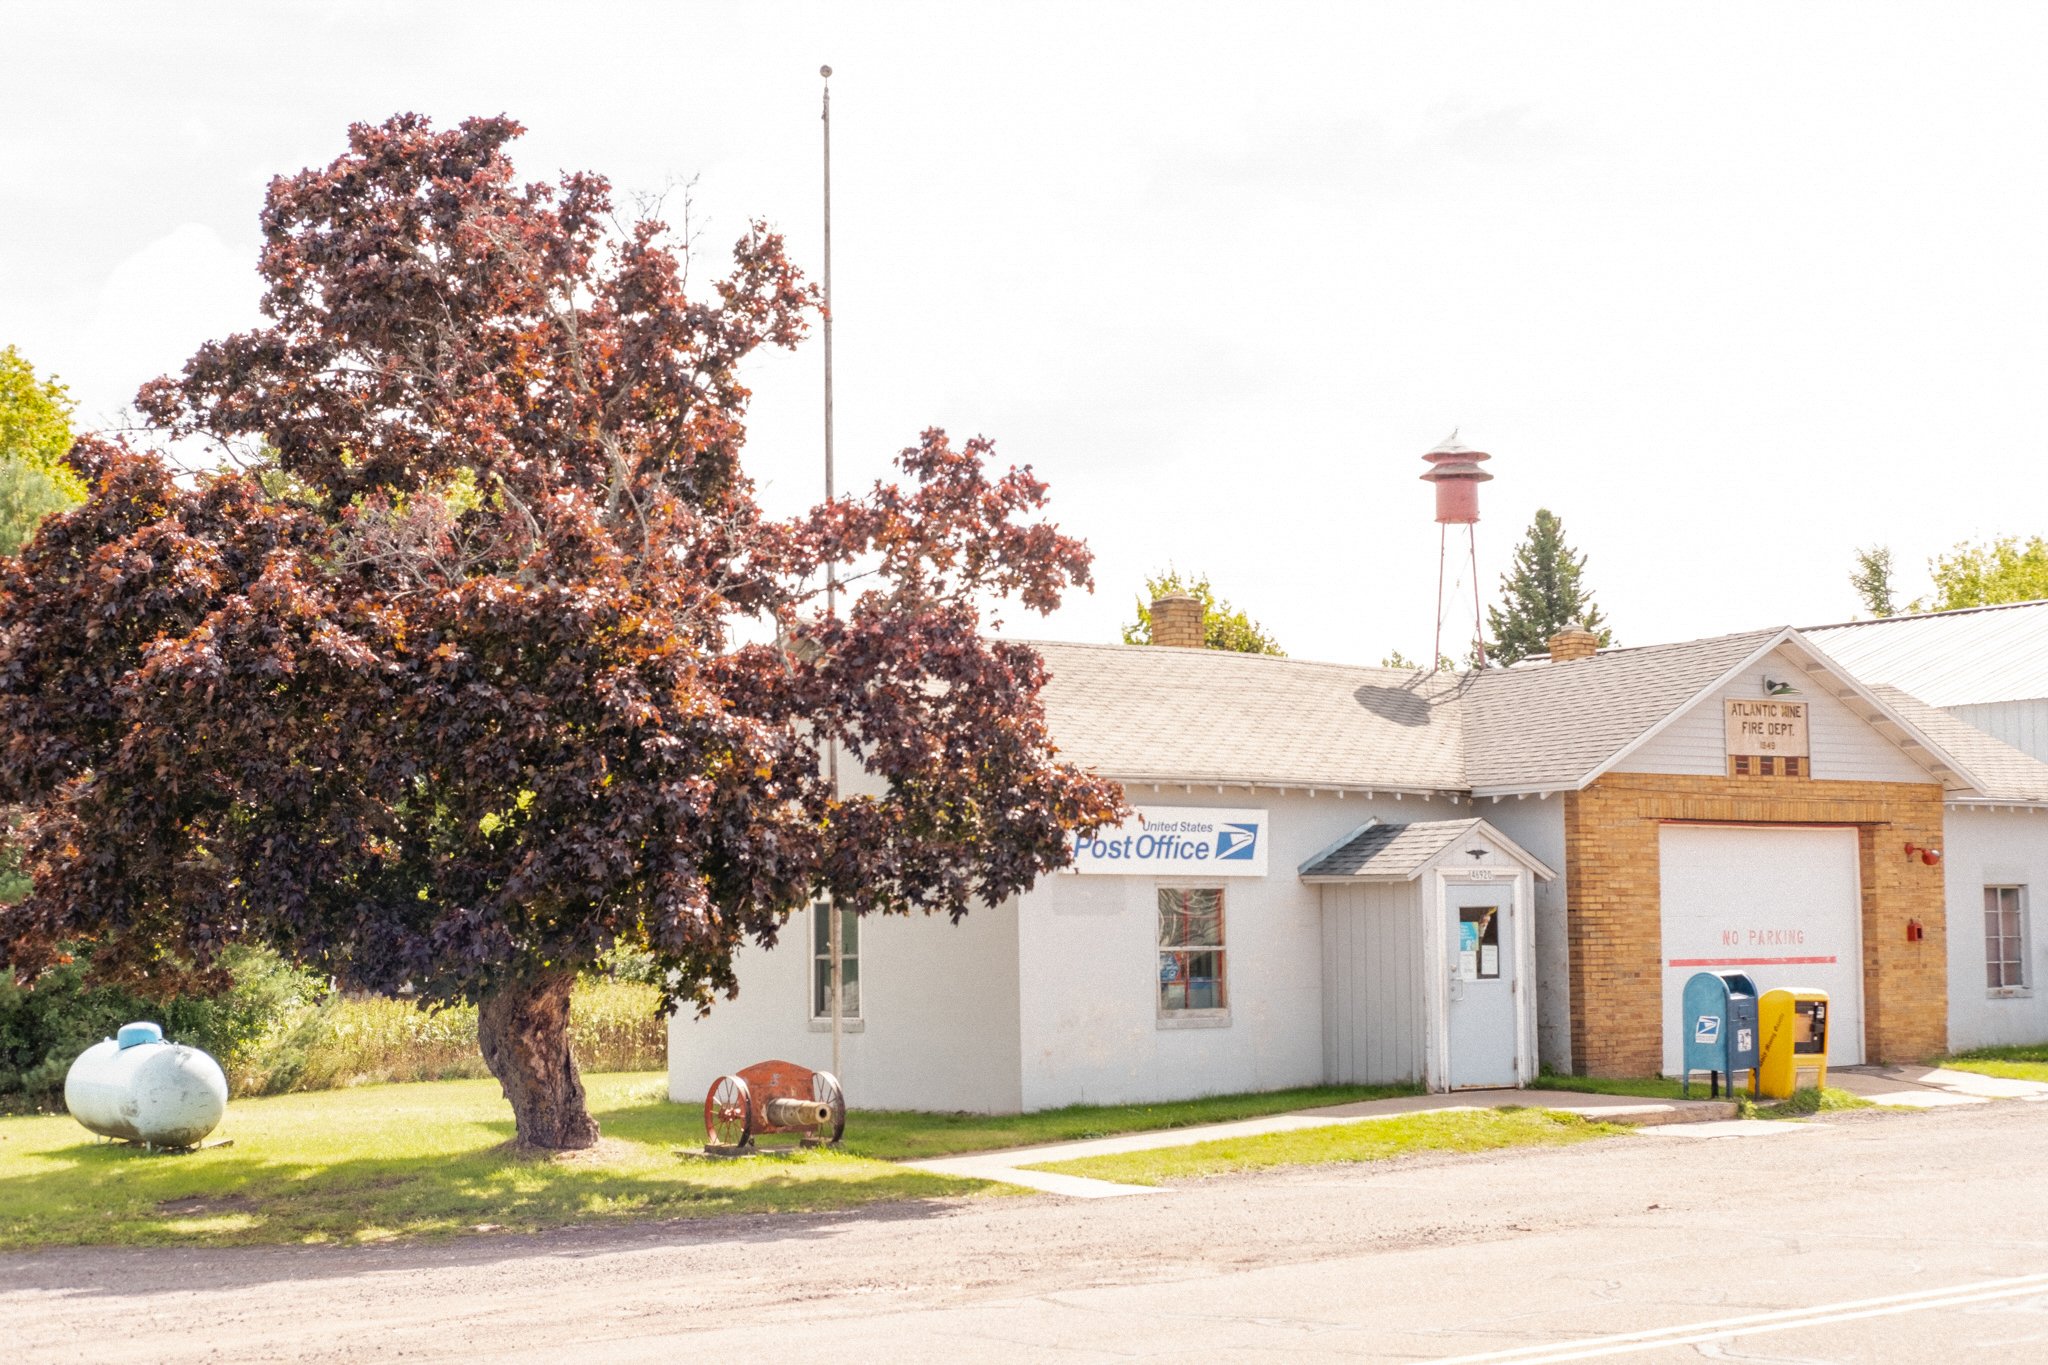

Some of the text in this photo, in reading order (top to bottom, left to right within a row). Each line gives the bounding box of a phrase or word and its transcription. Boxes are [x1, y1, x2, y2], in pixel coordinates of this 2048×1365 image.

[1731, 703, 1801, 718] ATLANTIC MINE
[1742, 721, 1795, 736] FIRE DEPT.
[1142, 820, 1213, 832] United States
[1074, 834, 1209, 860] Post Office
[1722, 930, 1804, 945] NO PARKING
